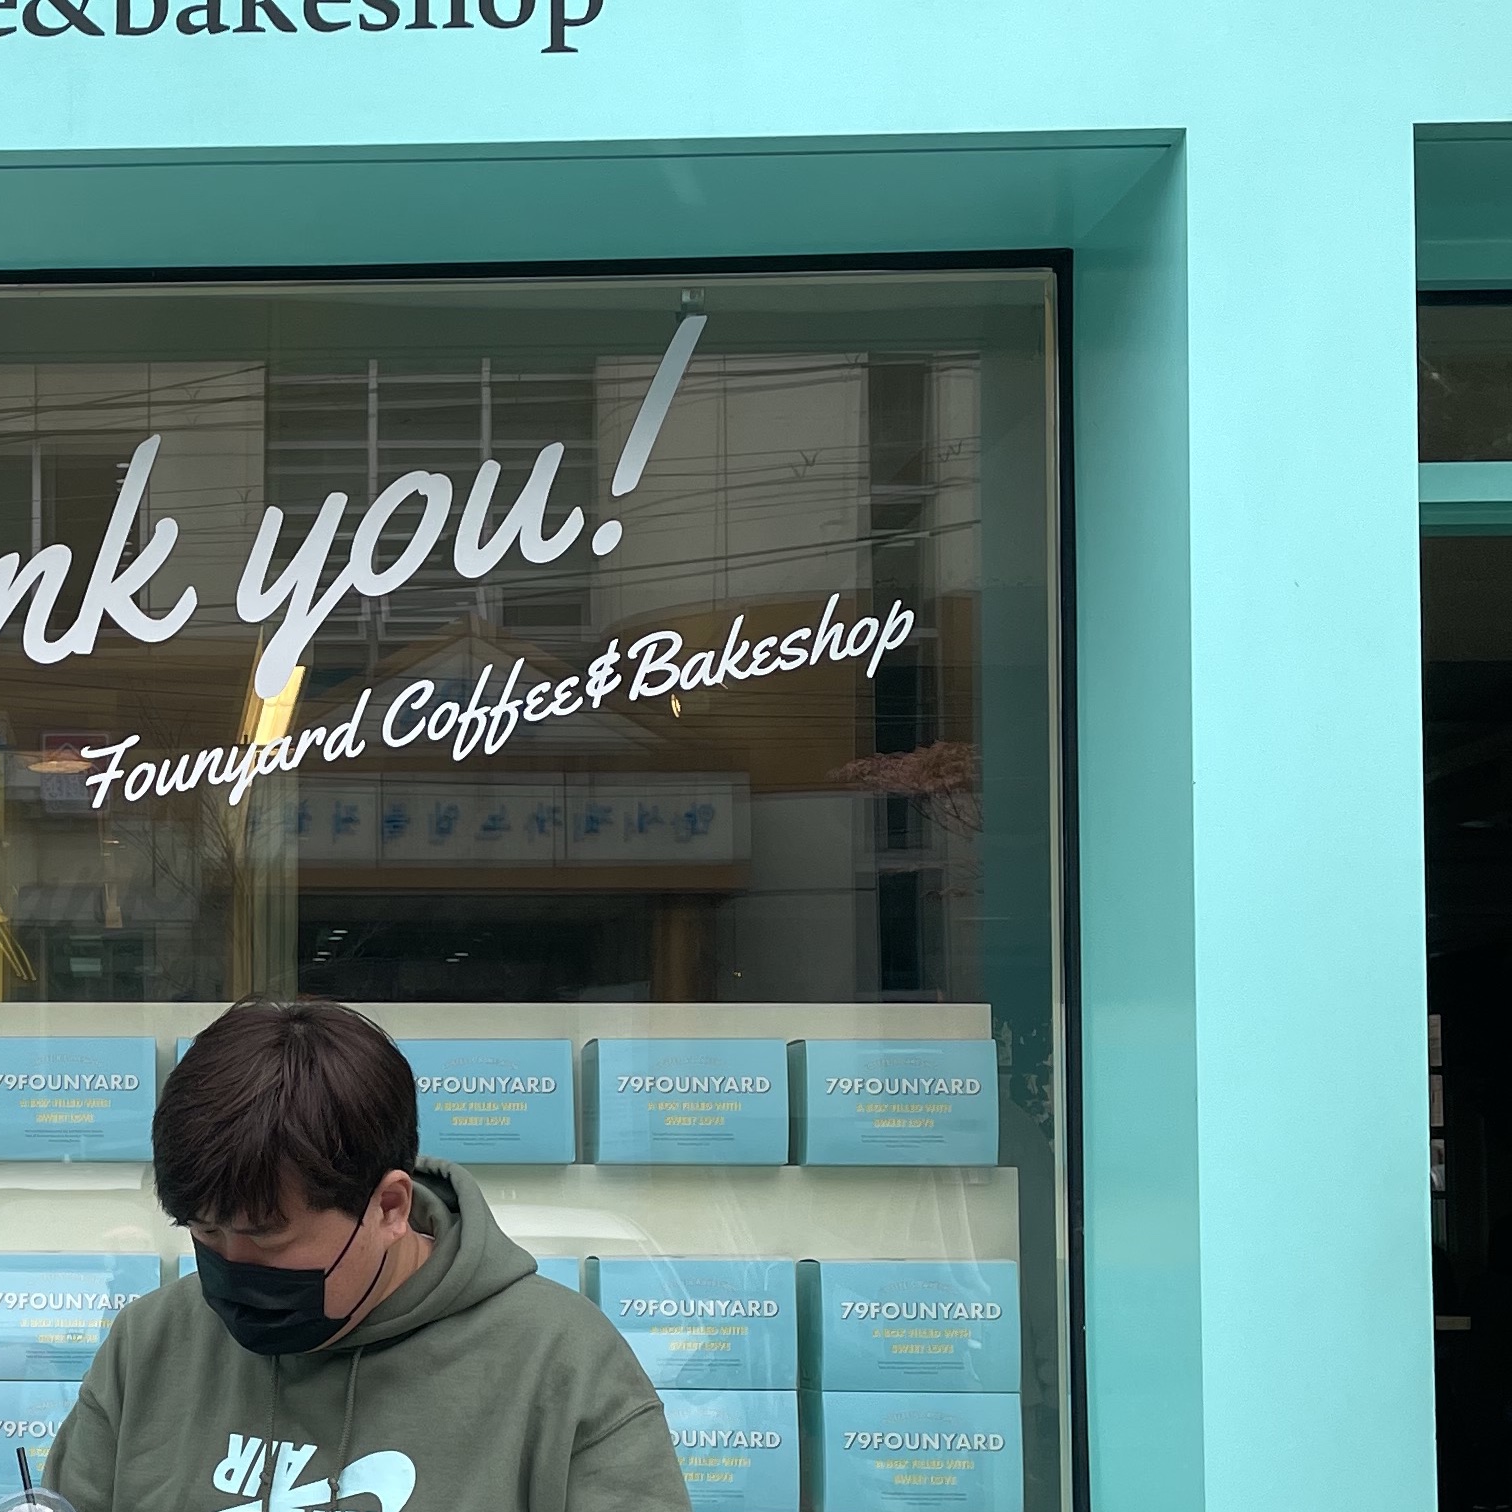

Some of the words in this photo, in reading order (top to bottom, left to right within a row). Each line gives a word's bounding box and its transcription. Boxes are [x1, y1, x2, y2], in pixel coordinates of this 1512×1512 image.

[237, 314, 707, 700] you!
[80, 688, 373, 809] Founyard
[414, 1076, 556, 1094] 9FOUNYARD
[616, 1076, 771, 1094] 79FOUNYARD
[826, 1078, 981, 1095] 79FOUNYARD
[618, 1299, 779, 1318] 79FOUNYARD
[840, 1301, 1002, 1321] 79FOUNYARD
[670, 1429, 781, 1449] OUNYARD
[843, 1431, 1006, 1451] 79FOUNYARD
[212, 1433, 318, 1498] AIR
